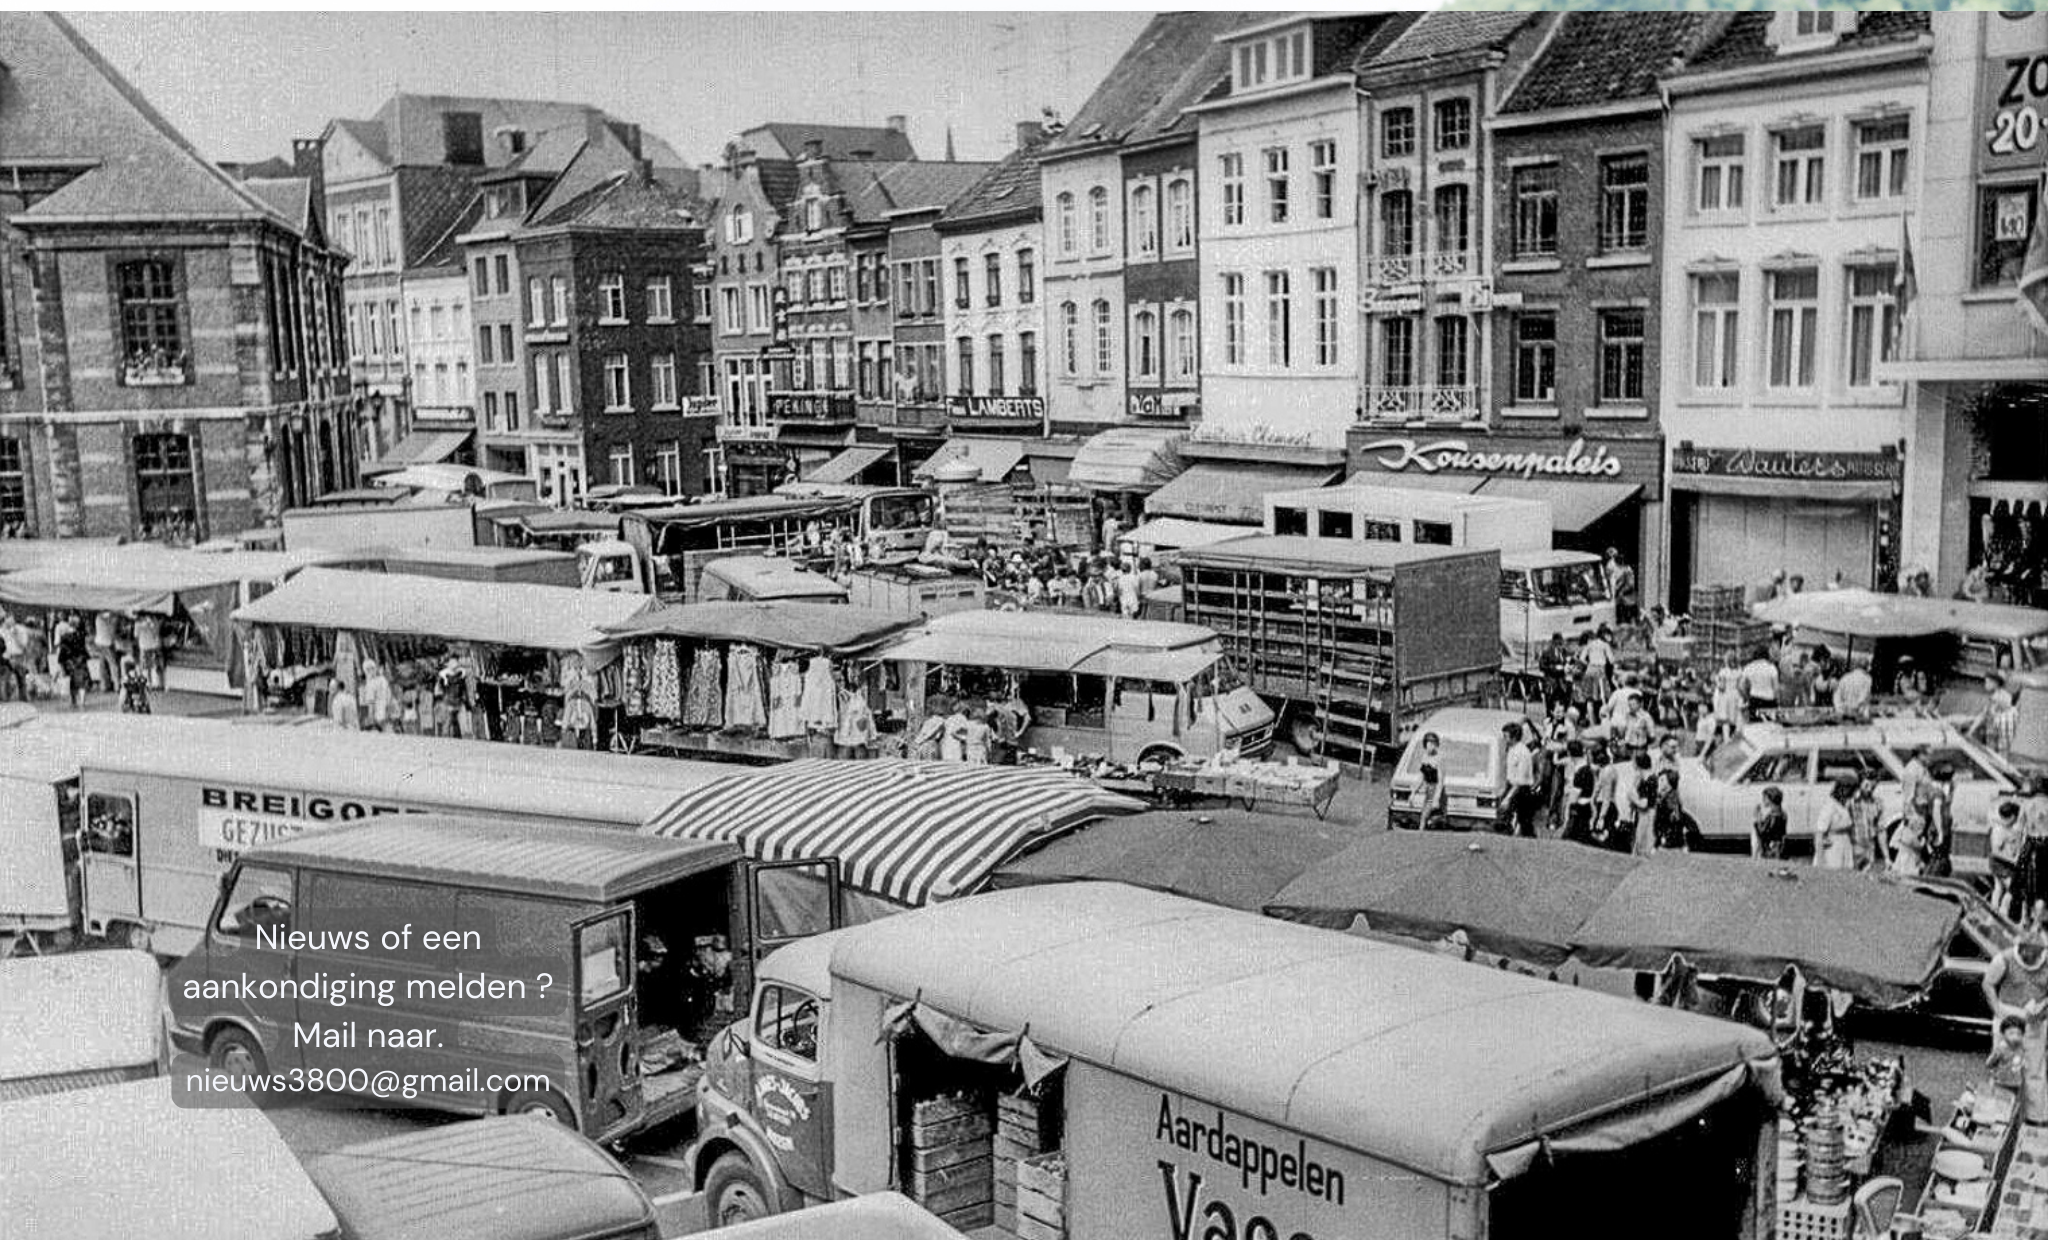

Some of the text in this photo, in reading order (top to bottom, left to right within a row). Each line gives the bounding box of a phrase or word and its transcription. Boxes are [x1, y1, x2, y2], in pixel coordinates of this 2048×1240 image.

[968, 397, 1043, 418] LAMBERTS
[1360, 437, 1621, 479] Kousenpaleis
[202, 787, 429, 823] BREIGO
[1156, 1093, 1344, 1205] Aardappelen
